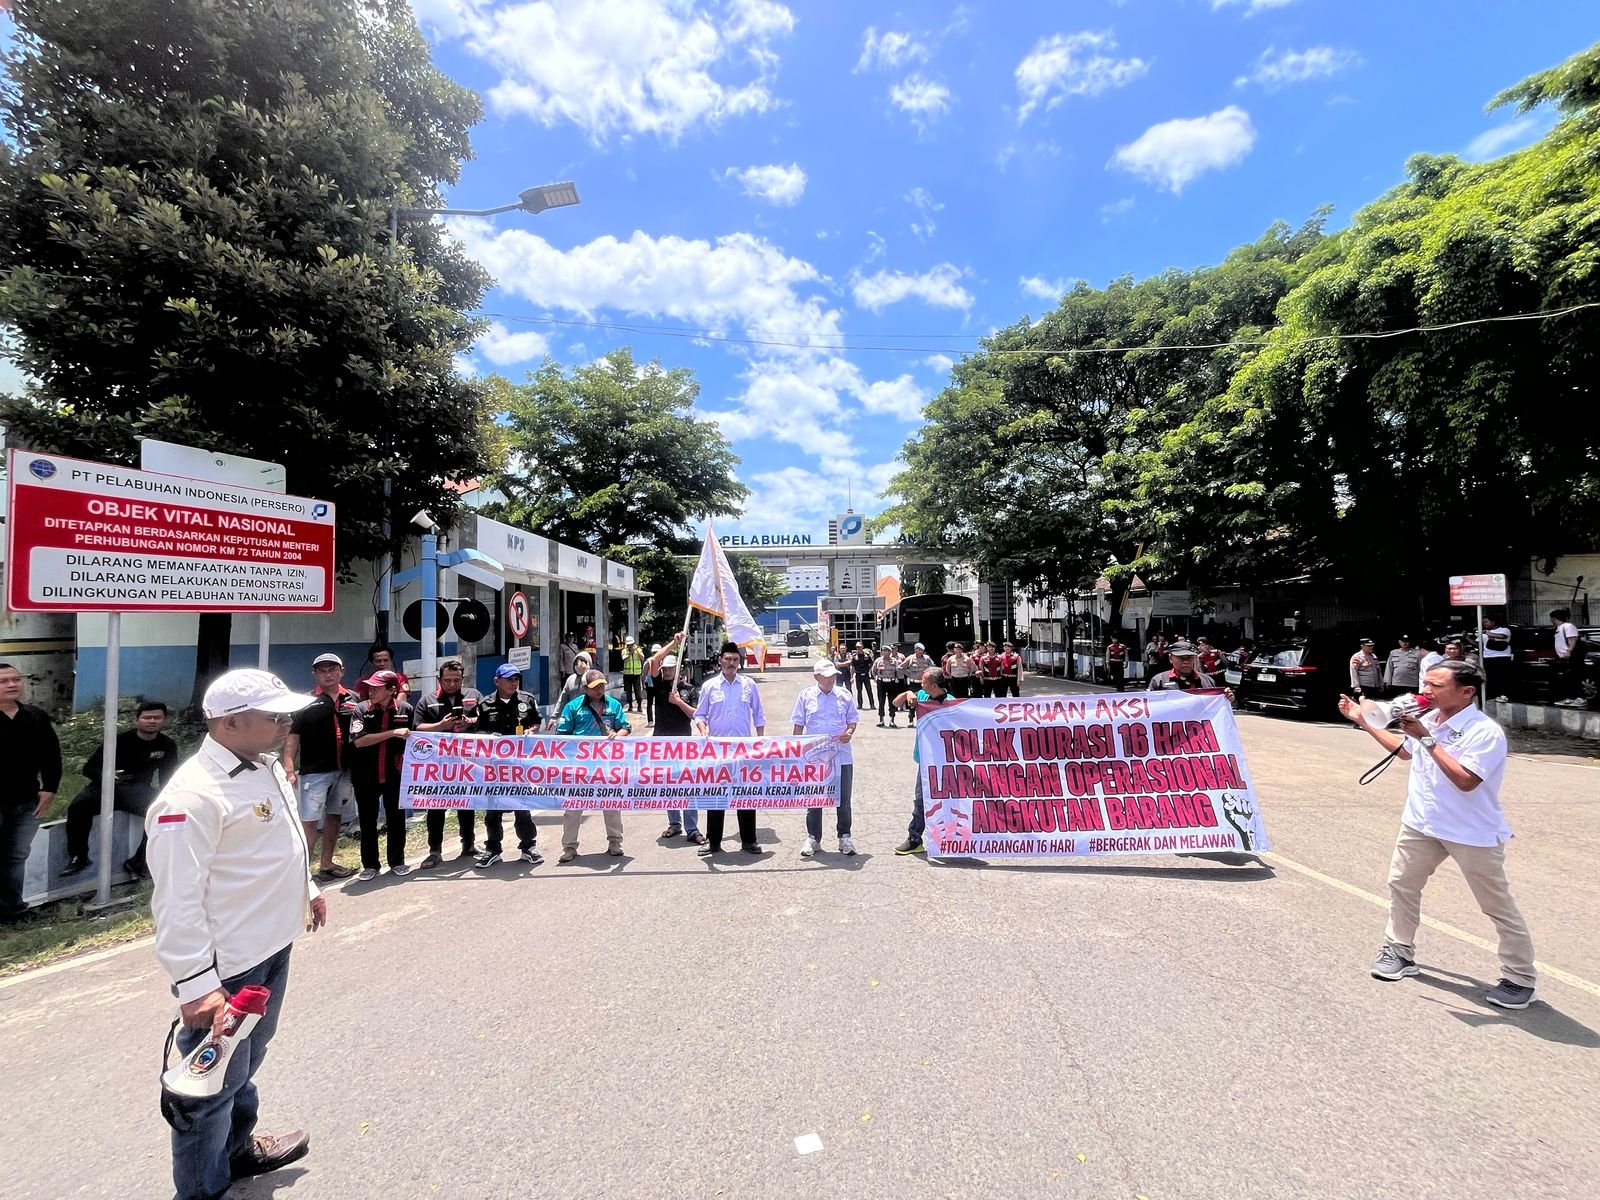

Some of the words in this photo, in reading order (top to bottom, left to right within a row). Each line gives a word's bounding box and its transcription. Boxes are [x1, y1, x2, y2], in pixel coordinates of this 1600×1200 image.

[72, 470, 91, 482] PT
[96, 473, 181, 495] PELABUHAN
[185, 487, 248, 505] INDONESIA
[251, 498, 305, 515] (PERSERO)
[88, 499, 159, 521] OBJEK
[163, 508, 213, 527] VITAL
[218, 515, 296, 536] NASIONAL
[44, 517, 131, 535] DITETAPKAN
[134, 525, 221, 543] BERDASARKAN
[223, 535, 281, 548] KEPUTUSAN
[282, 540, 320, 552] MENTERI
[722, 534, 811, 546] PELABUHAN
[75, 534, 174, 551] PERHUBUNGAN
[176, 542, 217, 554] NOMOR
[220, 545, 235, 555] KM
[237, 547, 249, 557] 72
[250, 549, 281, 559] TAHUN
[283, 551, 302, 561] 2004
[66, 554, 143, 569] DILARANG
[147, 559, 247, 575] MEMANFAATKAN
[250, 566, 282, 577] TANPA
[287, 568, 307, 579] IZIN,
[70, 571, 147, 584] DILARANG
[151, 574, 228, 587] MELAKUKAN
[231, 578, 305, 590] DEMONSTRASI
[42, 586, 157, 599] DILINGKUNGAN
[161, 590, 234, 601] PELABUHAN
[237, 592, 285, 602] TANJUNG
[284, 593, 319, 603] WANGI
[993, 700, 1086, 724] SERUAN
[1096, 697, 1151, 722] AKSI
[438, 738, 568, 760] MENOLAK
[576, 740, 625, 761] SKB
[634, 741, 801, 760] PEMBATASAN
[939, 728, 1018, 763] TOLAK
[1019, 724, 1113, 760] DURASI
[1118, 722, 1149, 757] 16
[1153, 719, 1221, 755] HARI
[411, 763, 475, 783] TRUK
[483, 765, 629, 785] BEROPERASI
[638, 766, 732, 785] SELAMA
[740, 766, 763, 783] 16
[771, 764, 825, 783] HARI
[928, 762, 1062, 800] LARANGAN
[1066, 754, 1248, 796] OPERASIONAL
[407, 786, 467, 796] PEMBATASAN
[469, 786, 483, 796] INI
[485, 787, 566, 797] MENYENGSARAKAN
[567, 787, 595, 797] NASIB
[596, 787, 625, 798] SOPIR,
[627, 787, 657, 798] BURUH
[659, 787, 701, 797] BONGKAR
[703, 786, 729, 797] MUAT,
[732, 786, 763, 796] TENAGA
[765, 786, 792, 796] KERJA
[794, 785, 825, 795] HARIAN
[412, 798, 471, 808] #AKSIDAMAI
[599, 799, 631, 809] DURASI
[633, 799, 689, 809] PEMBATASAN
[729, 797, 836, 809] #BERGERAKDANMELAWAN
[972, 798, 1104, 834] ANGKUTAN
[1105, 794, 1219, 829] BARANG
[940, 839, 977, 854] #TOLAK
[979, 839, 1034, 853] LARANGAN
[1037, 839, 1048, 853] 16
[1049, 839, 1075, 853] HARI
[1089, 837, 1151, 852] #BERGERAK
[1153, 836, 1177, 850] DAN
[1179, 834, 1236, 849] MELAWAN
